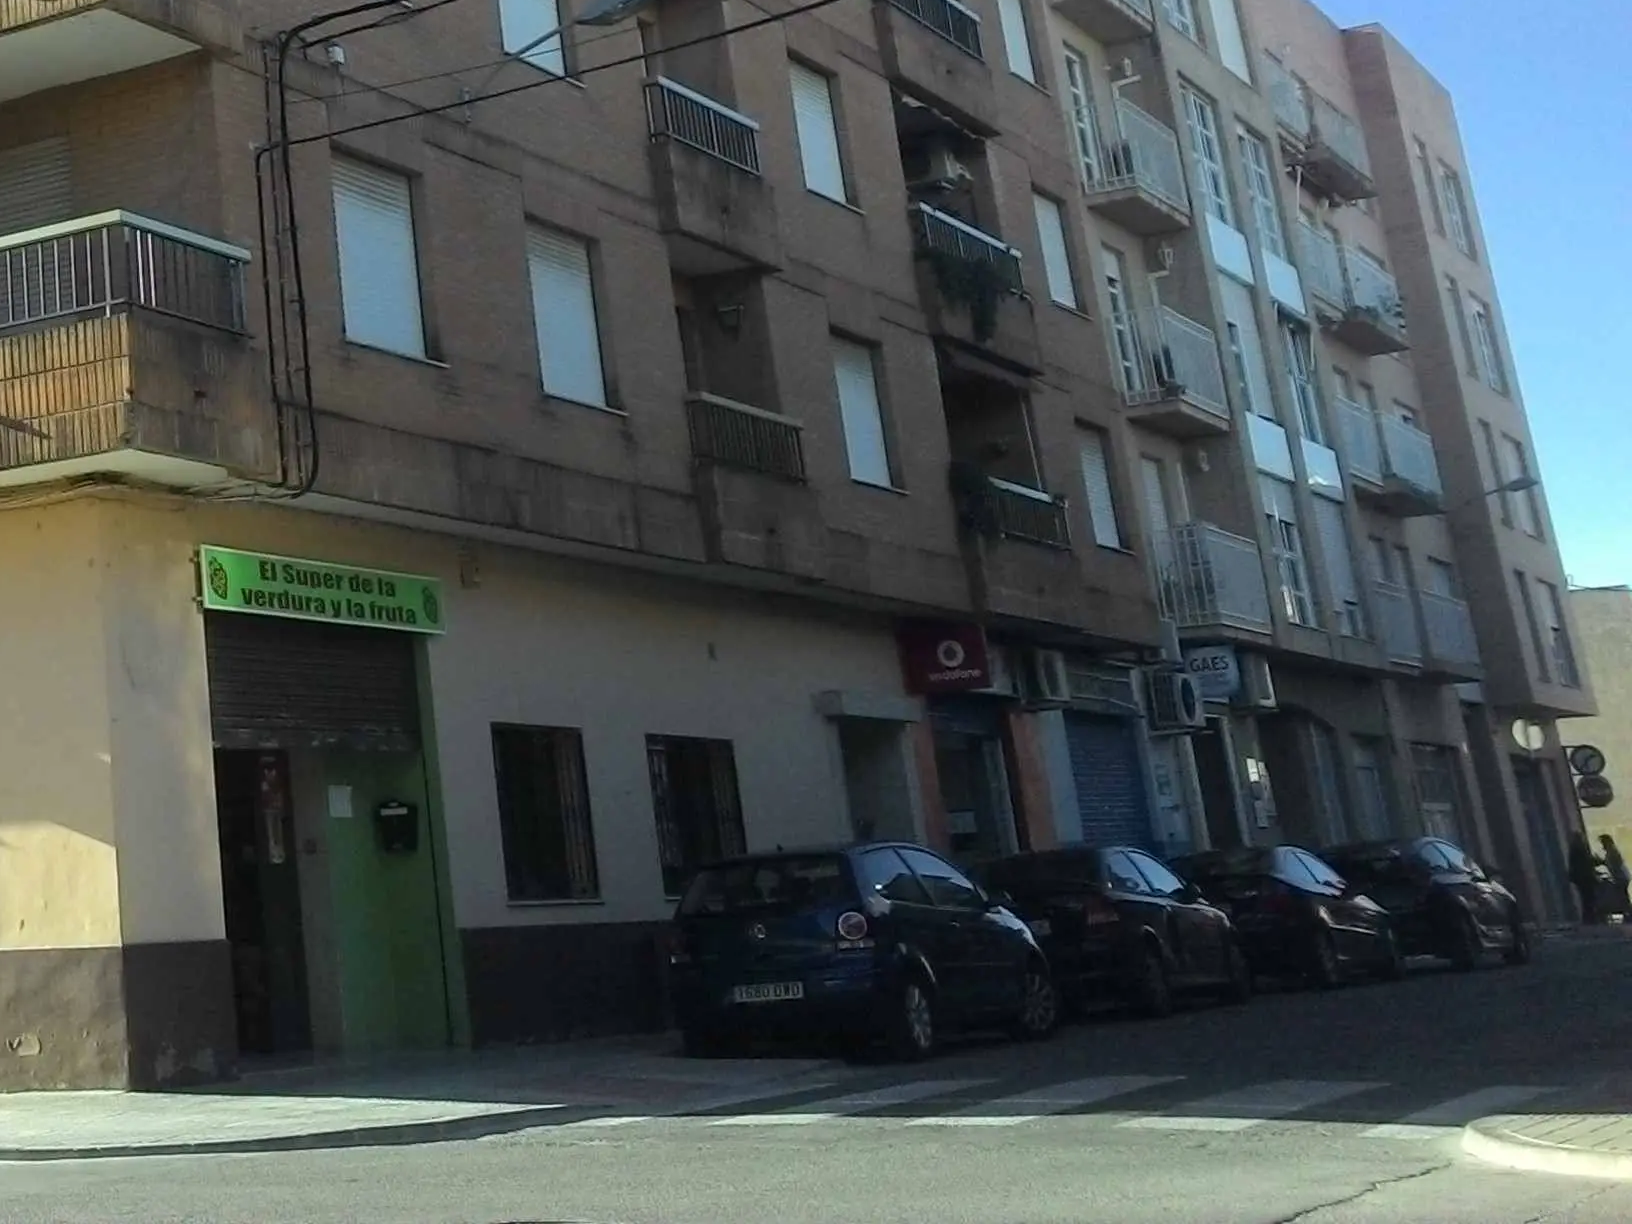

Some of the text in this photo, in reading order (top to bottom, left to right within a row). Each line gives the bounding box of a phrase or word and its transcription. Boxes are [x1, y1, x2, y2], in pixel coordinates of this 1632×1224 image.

[259, 560, 396, 597] El Super de la
[330, 599, 342, 618] y
[346, 598, 365, 618] la
[369, 601, 416, 624] fruta
[1190, 656, 1228, 672] GAES
